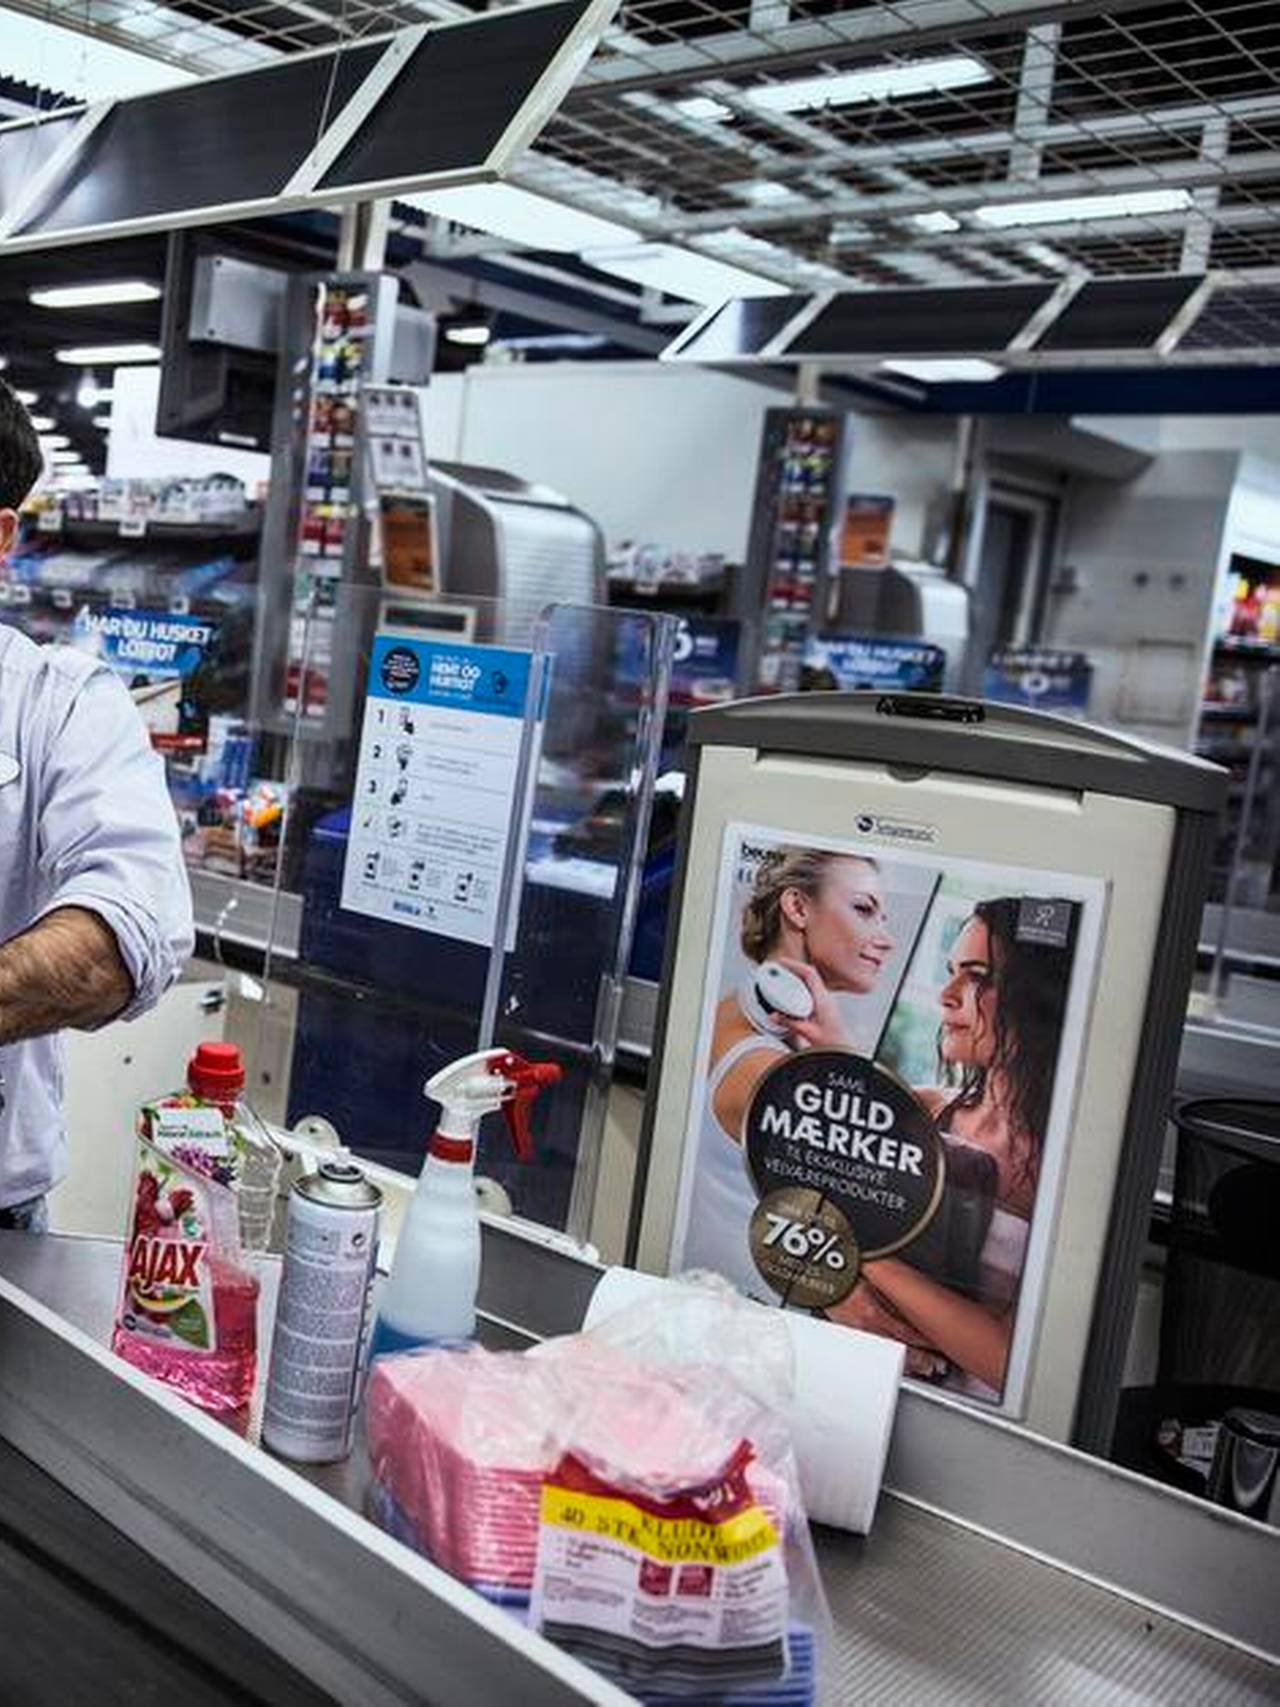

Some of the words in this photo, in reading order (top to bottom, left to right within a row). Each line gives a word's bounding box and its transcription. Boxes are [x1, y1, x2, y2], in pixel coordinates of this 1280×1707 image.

[794, 1082, 896, 1132] GULD
[760, 1105, 924, 1177] MÆRKER
[129, 1236, 203, 1291] AJAX
[763, 1212, 845, 1269] 76%
